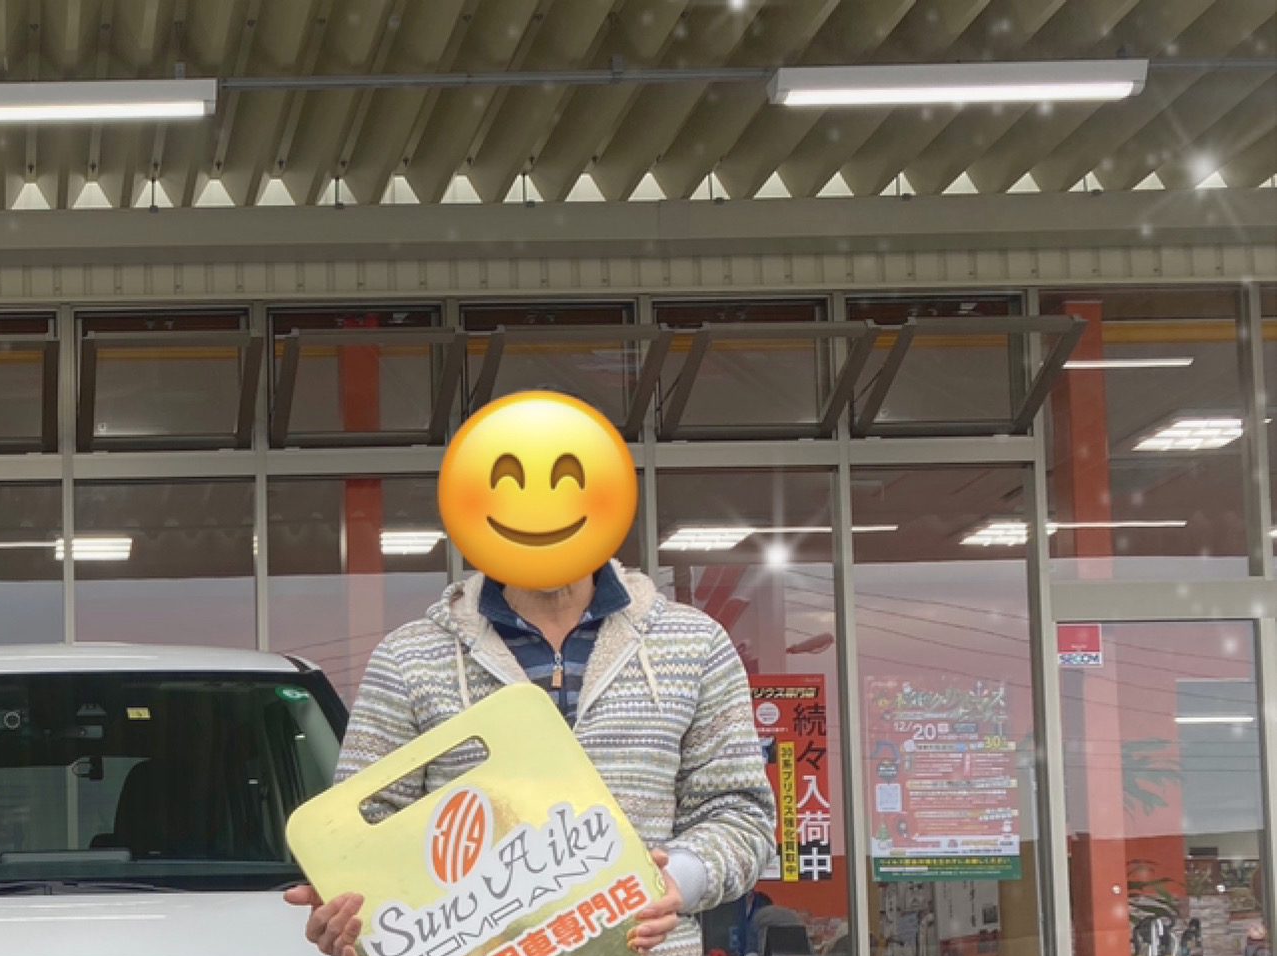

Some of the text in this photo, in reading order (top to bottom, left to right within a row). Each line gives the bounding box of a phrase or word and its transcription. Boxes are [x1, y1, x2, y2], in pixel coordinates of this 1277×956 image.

[481, 808, 611, 899] Aiku
[793, 702, 832, 882] 続々入荷中
